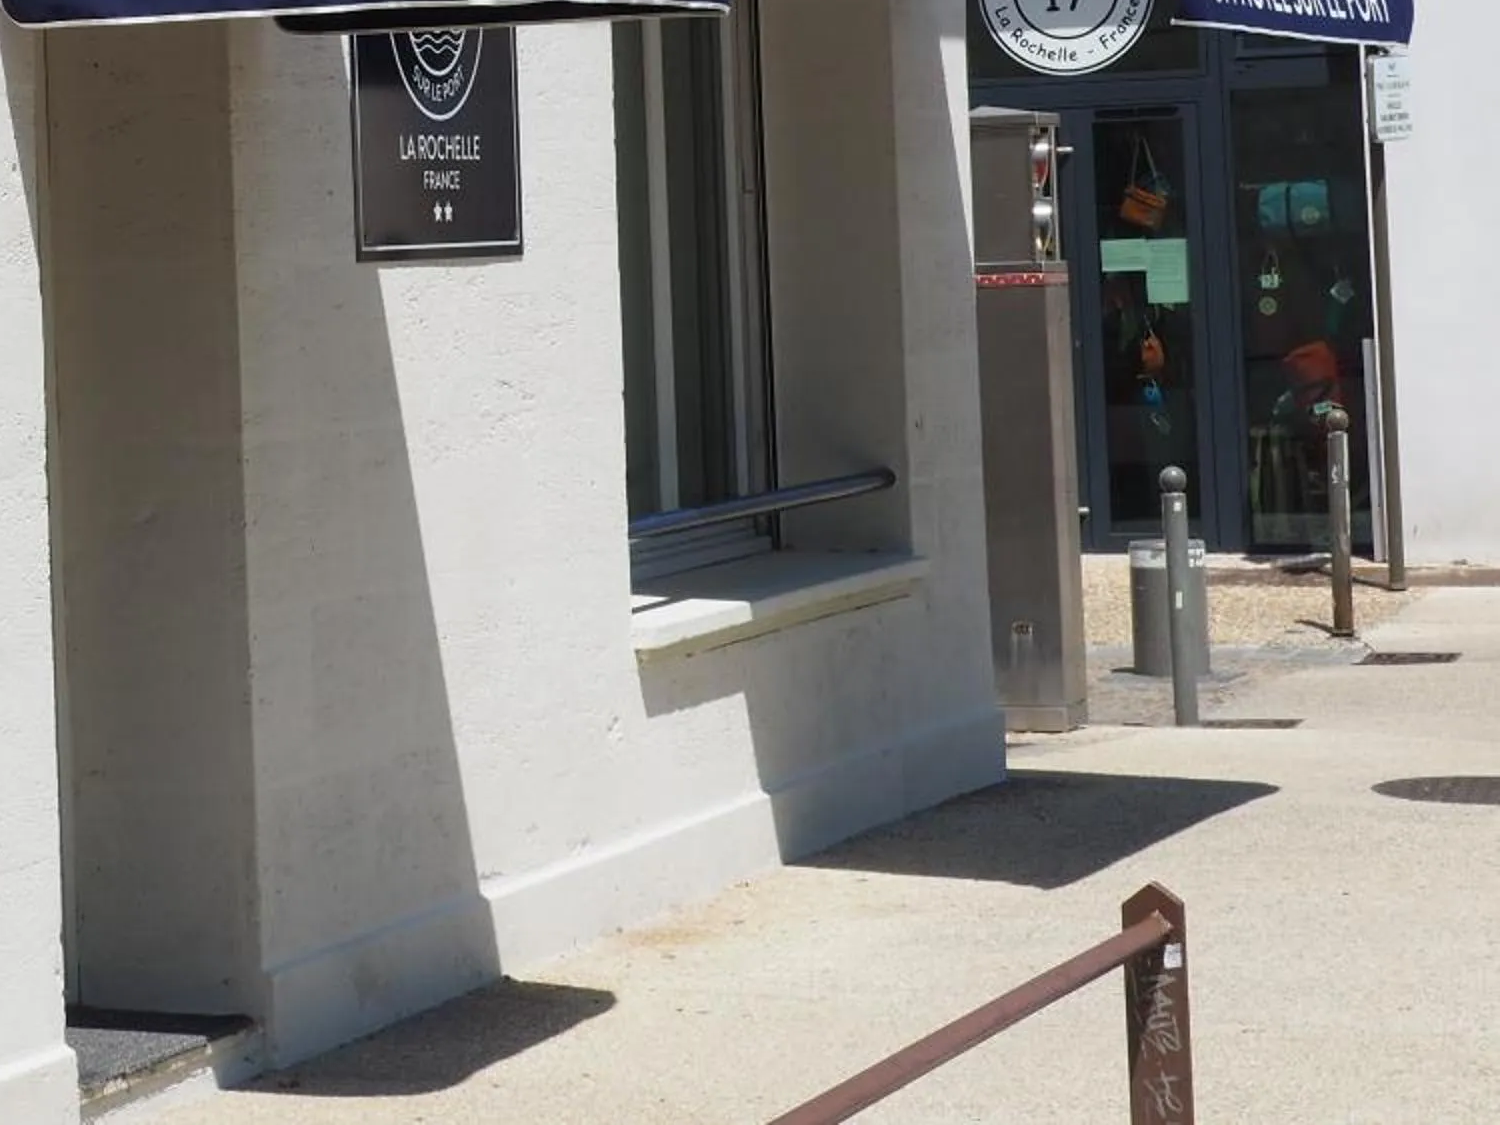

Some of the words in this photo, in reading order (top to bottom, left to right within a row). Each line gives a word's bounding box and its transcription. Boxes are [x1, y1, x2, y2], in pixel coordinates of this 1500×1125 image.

[995, 5, 1011, 28] La
[1010, 27, 1078, 63] Rochelle
[412, 64, 431, 98] SUR
[431, 82, 443, 102] LE
[443, 64, 465, 100] PORT
[399, 134, 417, 161] LA
[417, 134, 480, 161] ROCHELLE
[423, 170, 461, 190] FRANCE
